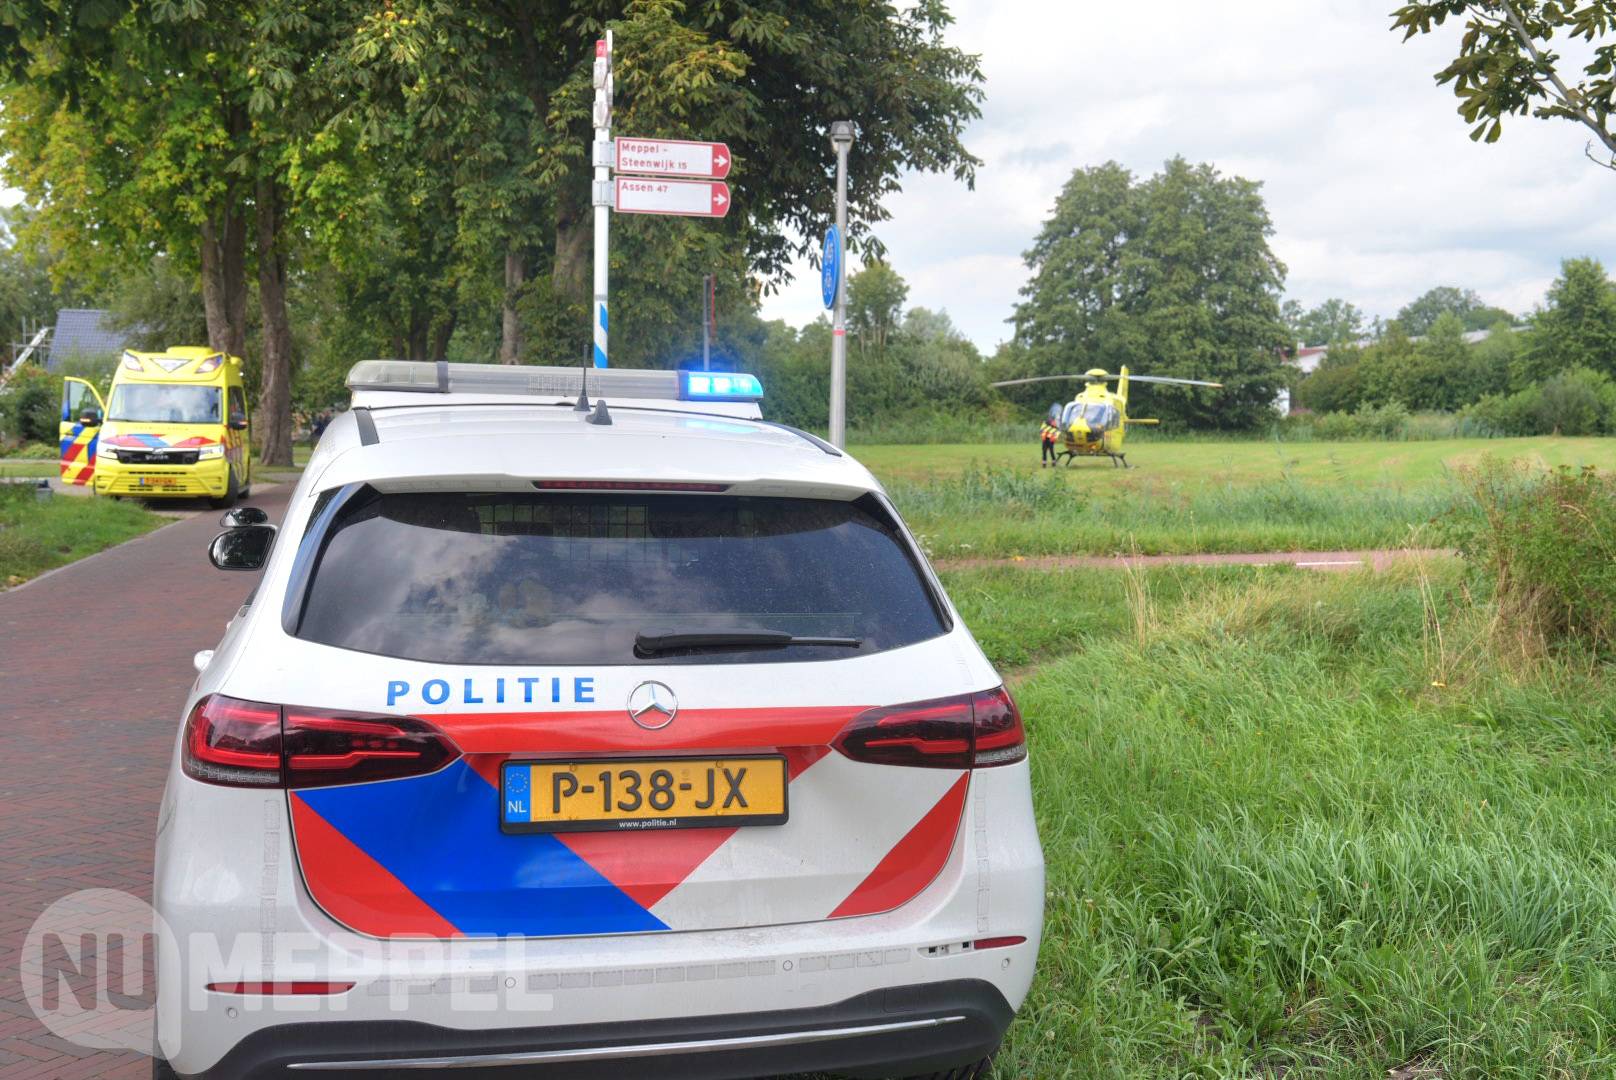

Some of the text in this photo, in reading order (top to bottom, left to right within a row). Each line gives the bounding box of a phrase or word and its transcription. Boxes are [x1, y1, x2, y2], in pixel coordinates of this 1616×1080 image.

[622, 143, 659, 154] Meppel
[622, 158, 674, 170] Steenwijk
[621, 182, 668, 193] Assen 47
[386, 677, 595, 706] POLITIE
[552, 768, 748, 813] P-138-JX
[508, 800, 527, 813] NL
[618, 818, 677, 828] www.politie.nl
